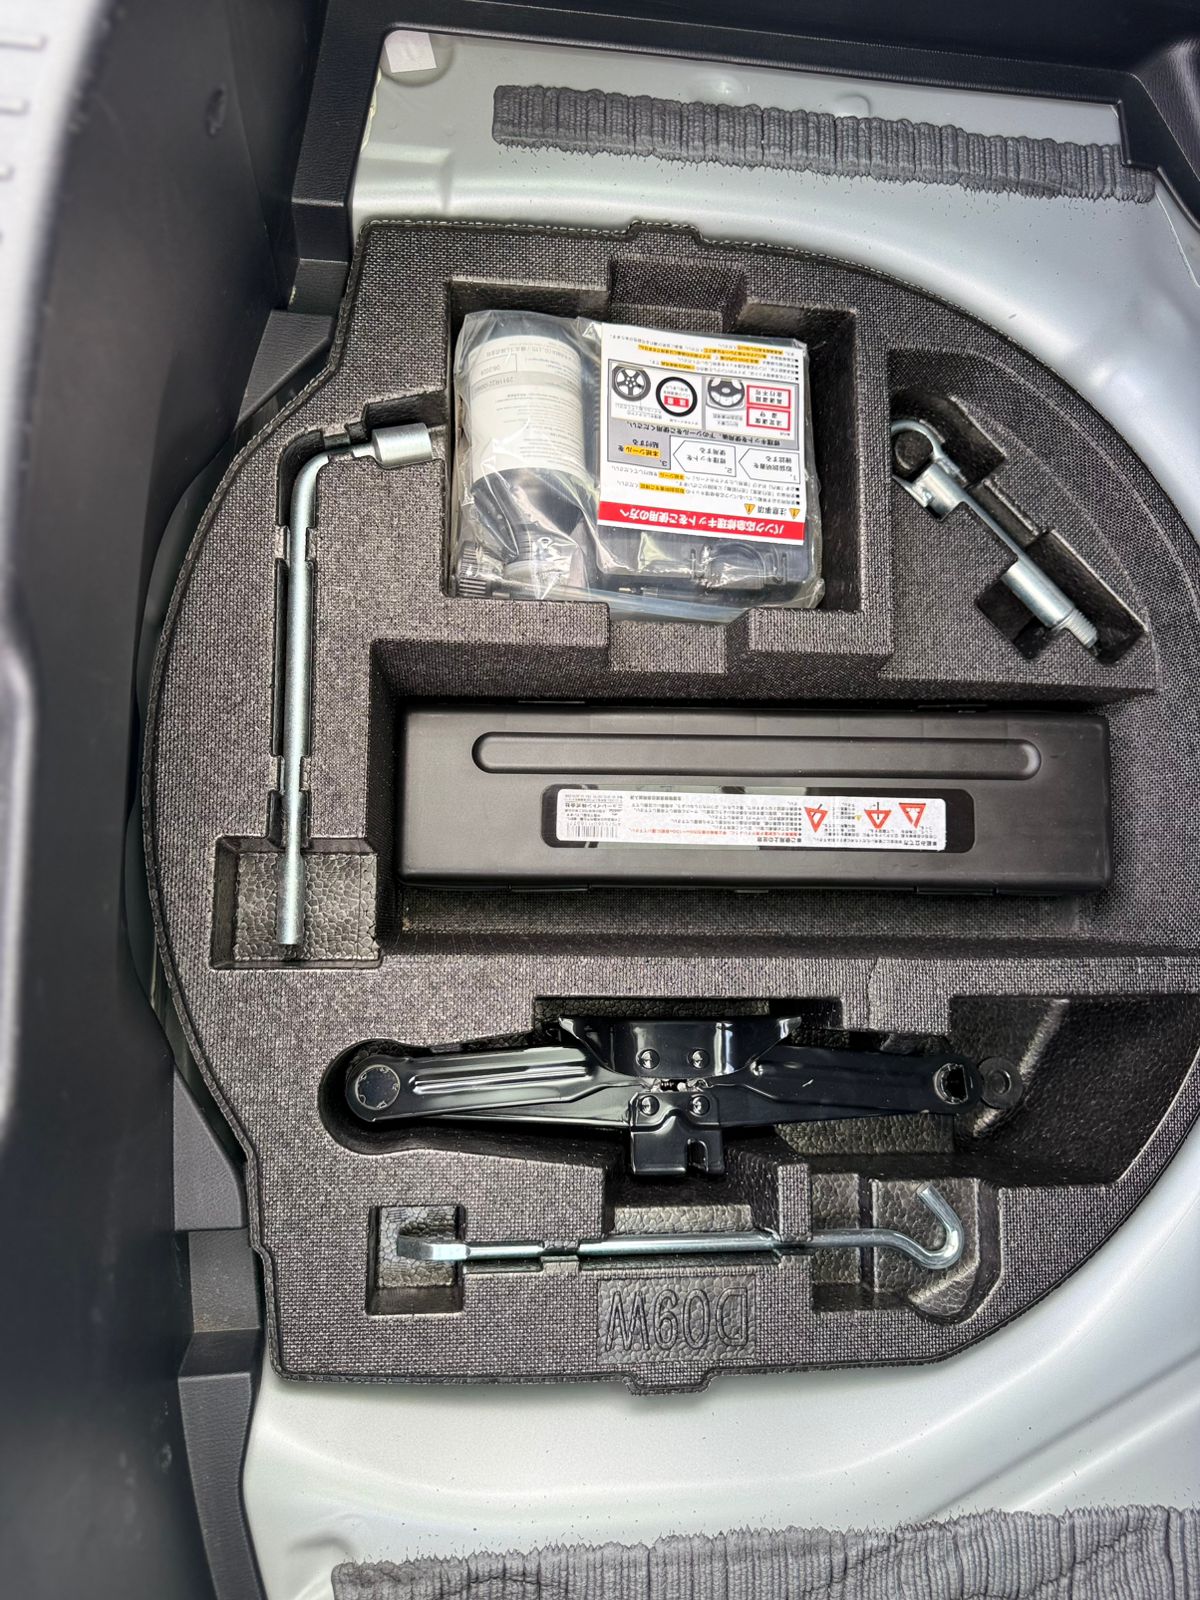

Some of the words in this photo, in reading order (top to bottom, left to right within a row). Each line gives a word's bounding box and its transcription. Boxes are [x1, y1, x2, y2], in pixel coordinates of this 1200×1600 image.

[632, 439, 658, 447] 貼付する
[699, 447, 725, 455] 使用する
[686, 454, 725, 464] 修理キットを
[765, 455, 791, 463] 確認する
[753, 462, 791, 471] 取扱説明書を
[757, 505, 786, 515] 注意事項
[619, 507, 784, 535] パンク応急修理キットをご使用の方へ
[605, 1287, 749, 1351] D09W
